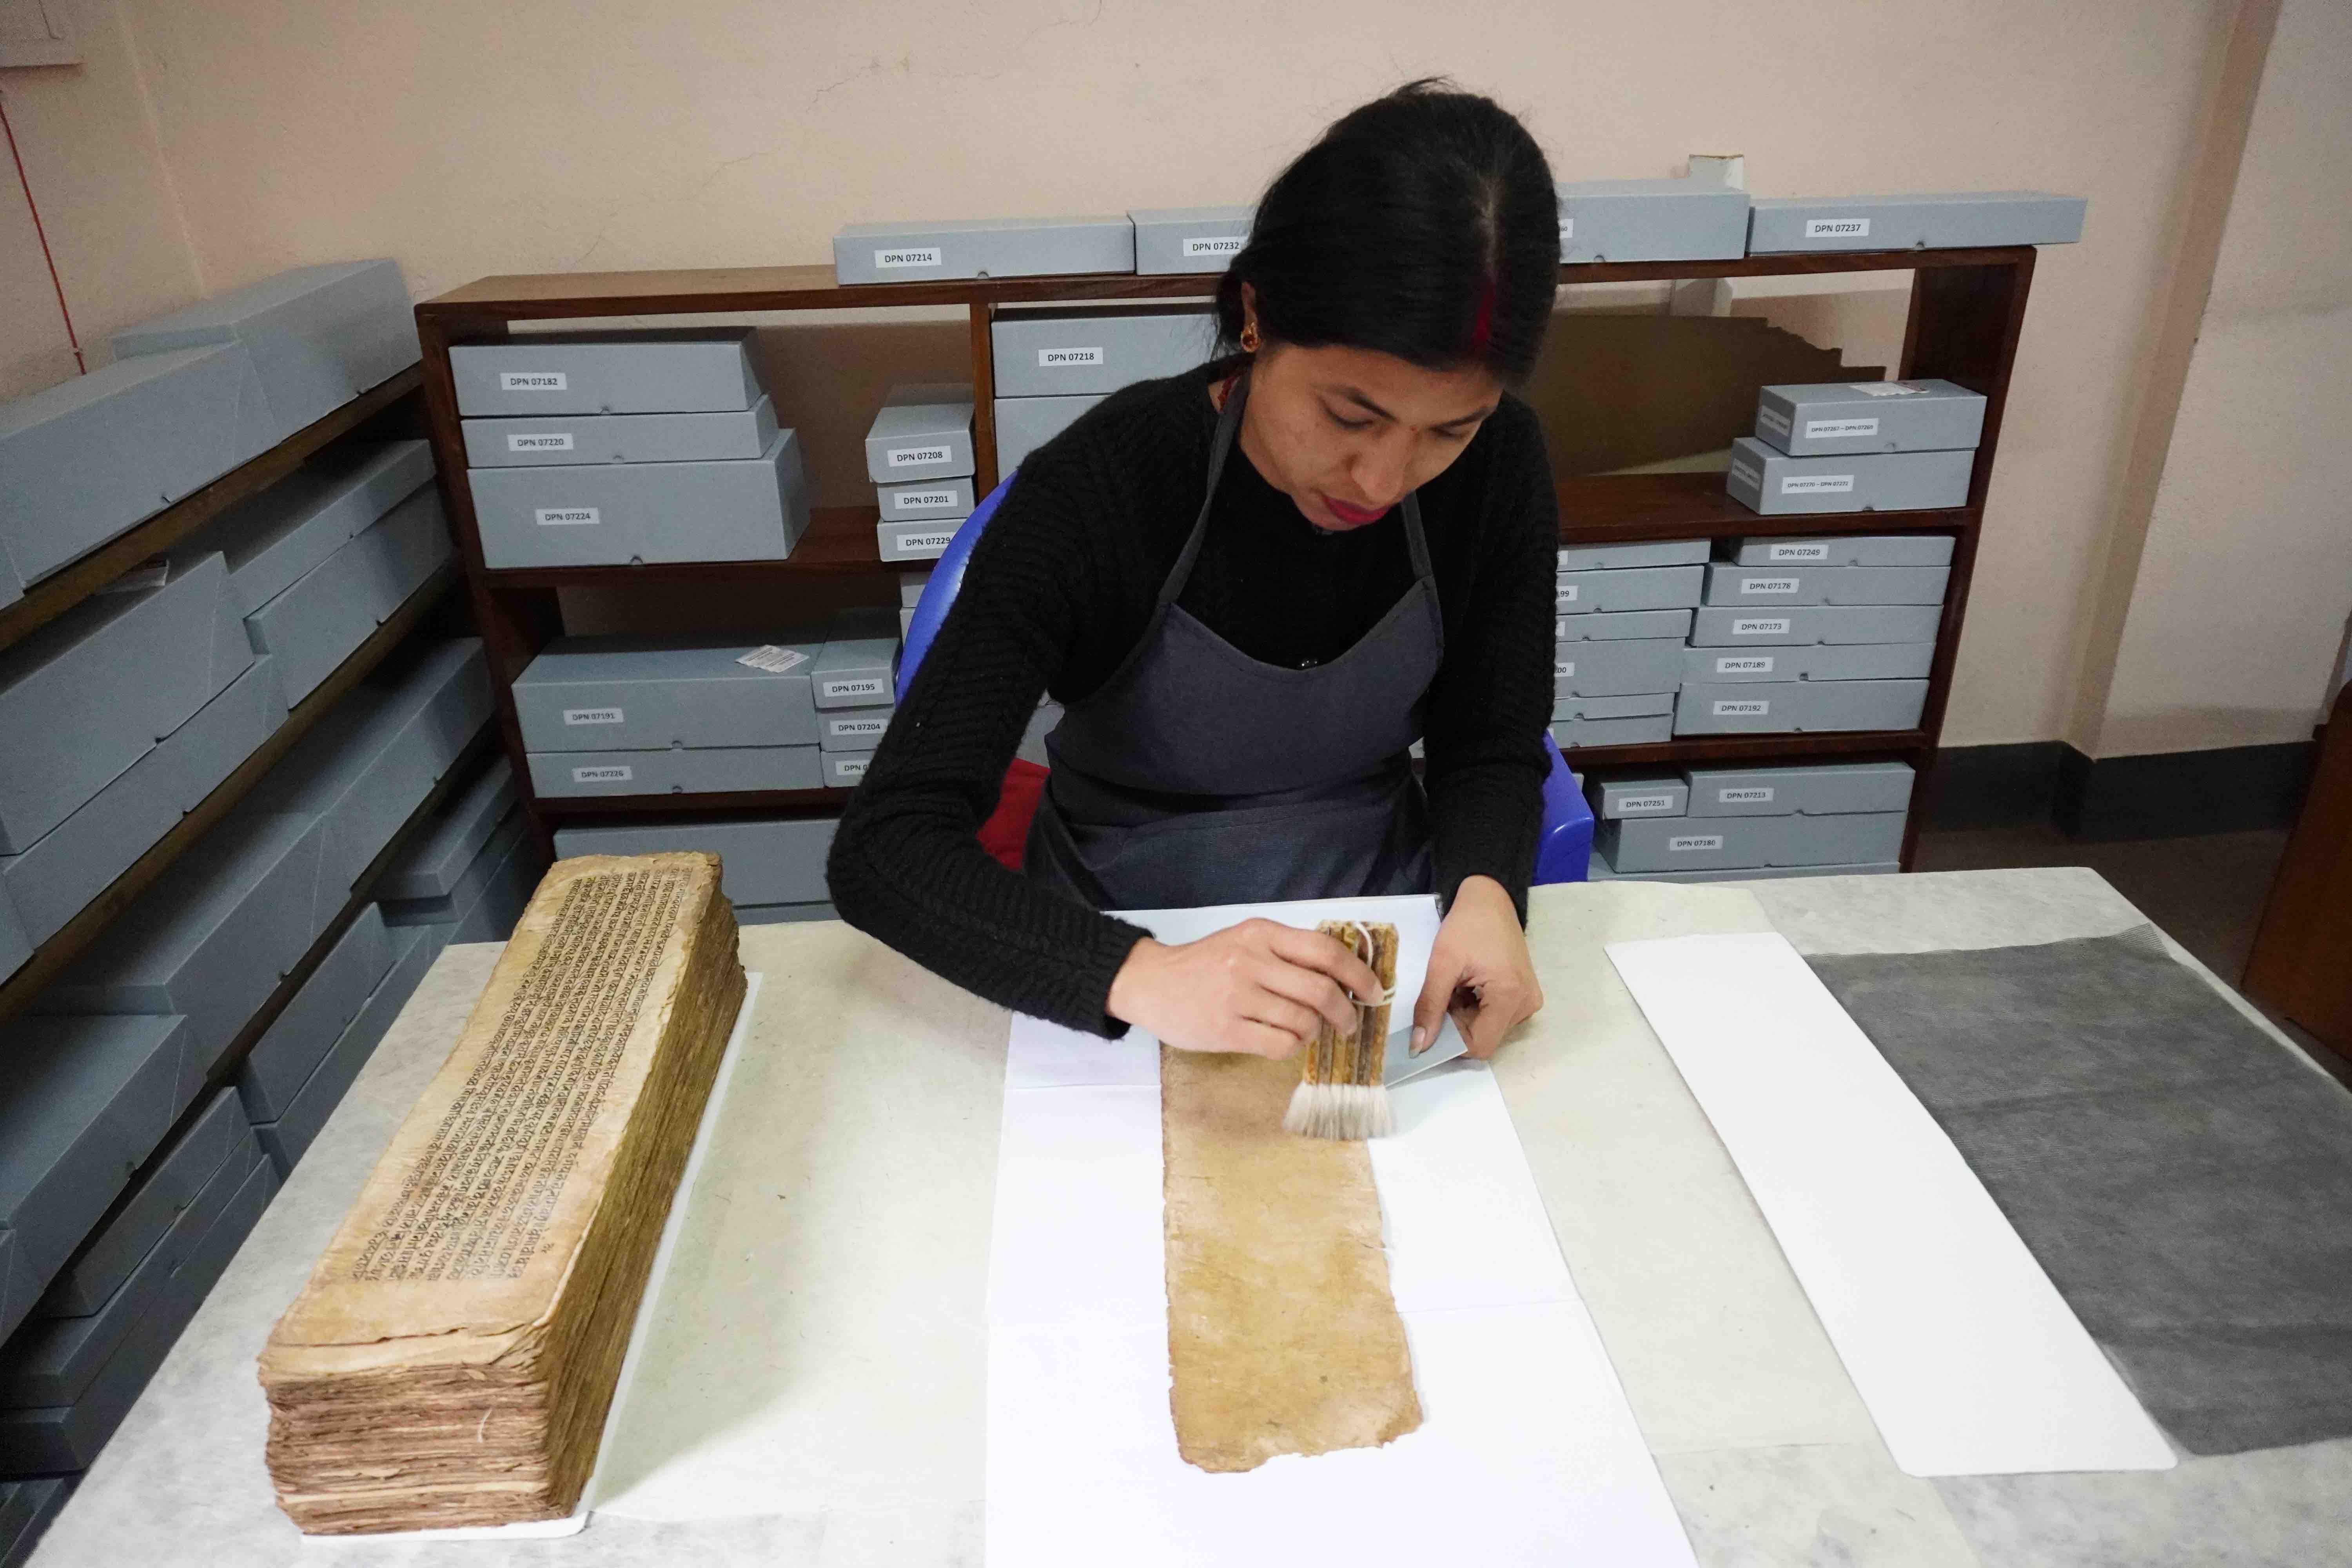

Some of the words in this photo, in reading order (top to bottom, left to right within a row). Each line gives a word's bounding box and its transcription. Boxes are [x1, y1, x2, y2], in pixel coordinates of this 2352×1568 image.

[1835, 224, 1861, 232] 07237
[1214, 242, 1240, 250] 07232
[917, 452, 942, 460] 07208
